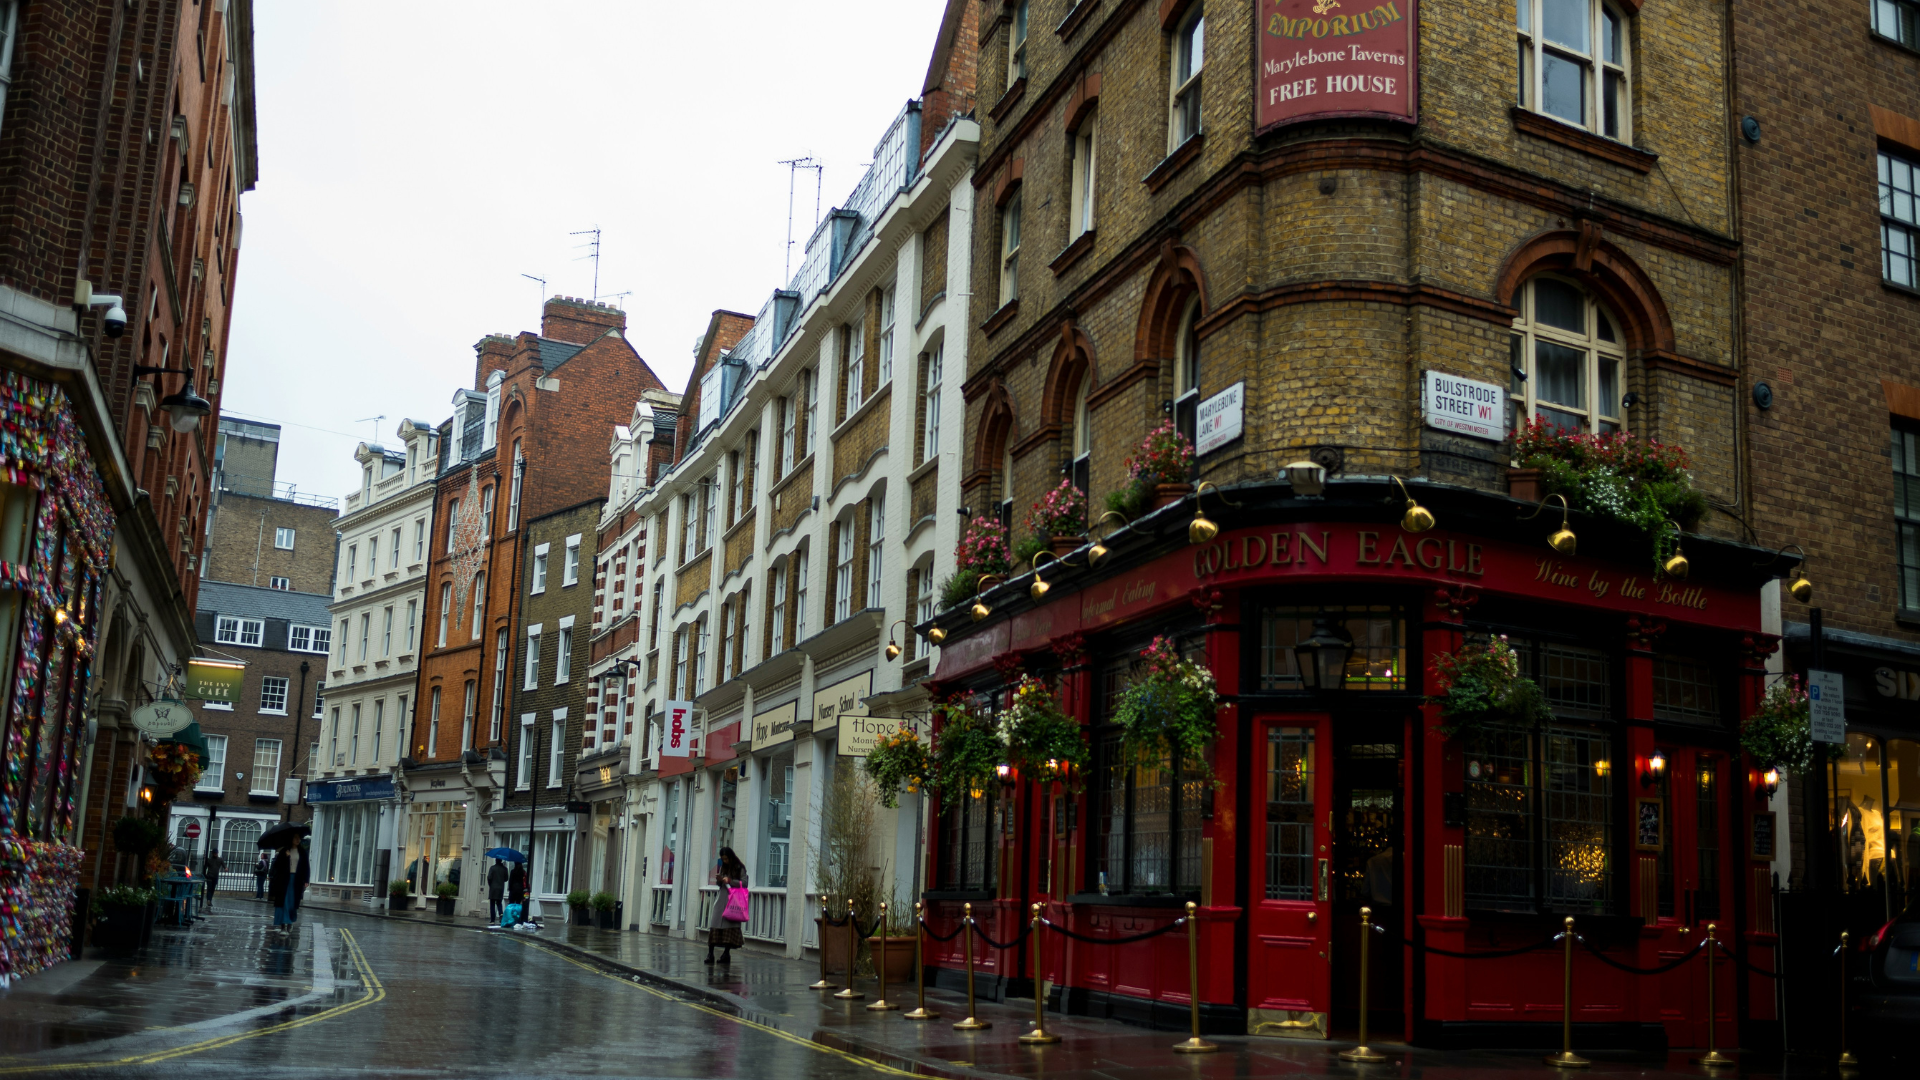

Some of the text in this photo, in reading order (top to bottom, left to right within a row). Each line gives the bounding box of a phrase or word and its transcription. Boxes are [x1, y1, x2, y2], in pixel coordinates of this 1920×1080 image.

[1267, 2, 1403, 40] EMPORIUM
[1264, 44, 1405, 78] Marylebone Taverns
[1269, 75, 1397, 106] FREE HOUSE
[1199, 389, 1237, 421] MARYLEBONE
[1435, 378, 1496, 405] BULSTRODE
[1435, 395, 1492, 421] STREET W1
[1199, 414, 1222, 438] LANE W1
[1435, 418, 1489, 435] CITY OF WESTMINSTER
[1193, 531, 1485, 579] GOLDEN EAGLE
[1535, 556, 1708, 609] Wine by the Bottle
[1081, 579, 1156, 623] Informal Eating
[818, 692, 855, 720] Nursery School
[671, 708, 687, 749] hobs
[756, 722, 768, 744] Hope
[853, 718, 895, 736] Hope
